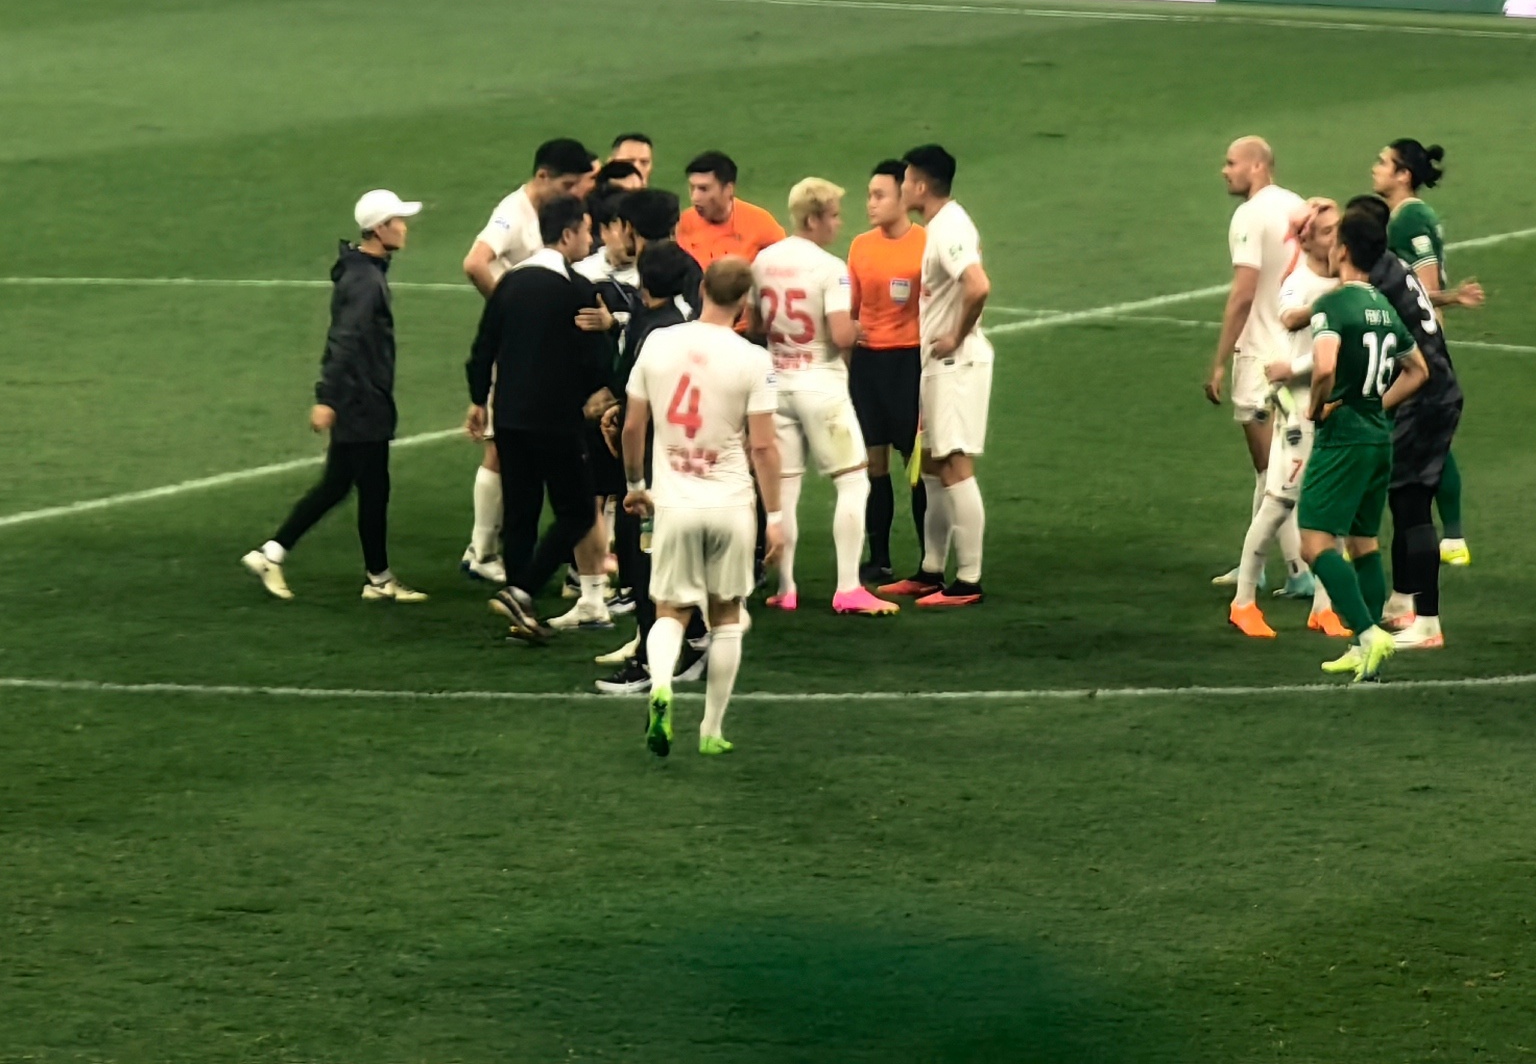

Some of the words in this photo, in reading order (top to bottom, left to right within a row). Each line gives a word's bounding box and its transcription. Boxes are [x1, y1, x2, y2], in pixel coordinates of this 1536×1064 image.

[760, 286, 816, 345] 25
[1362, 331, 1397, 398] 16
[666, 372, 703, 439] 4
[1288, 459, 1303, 484] 7
